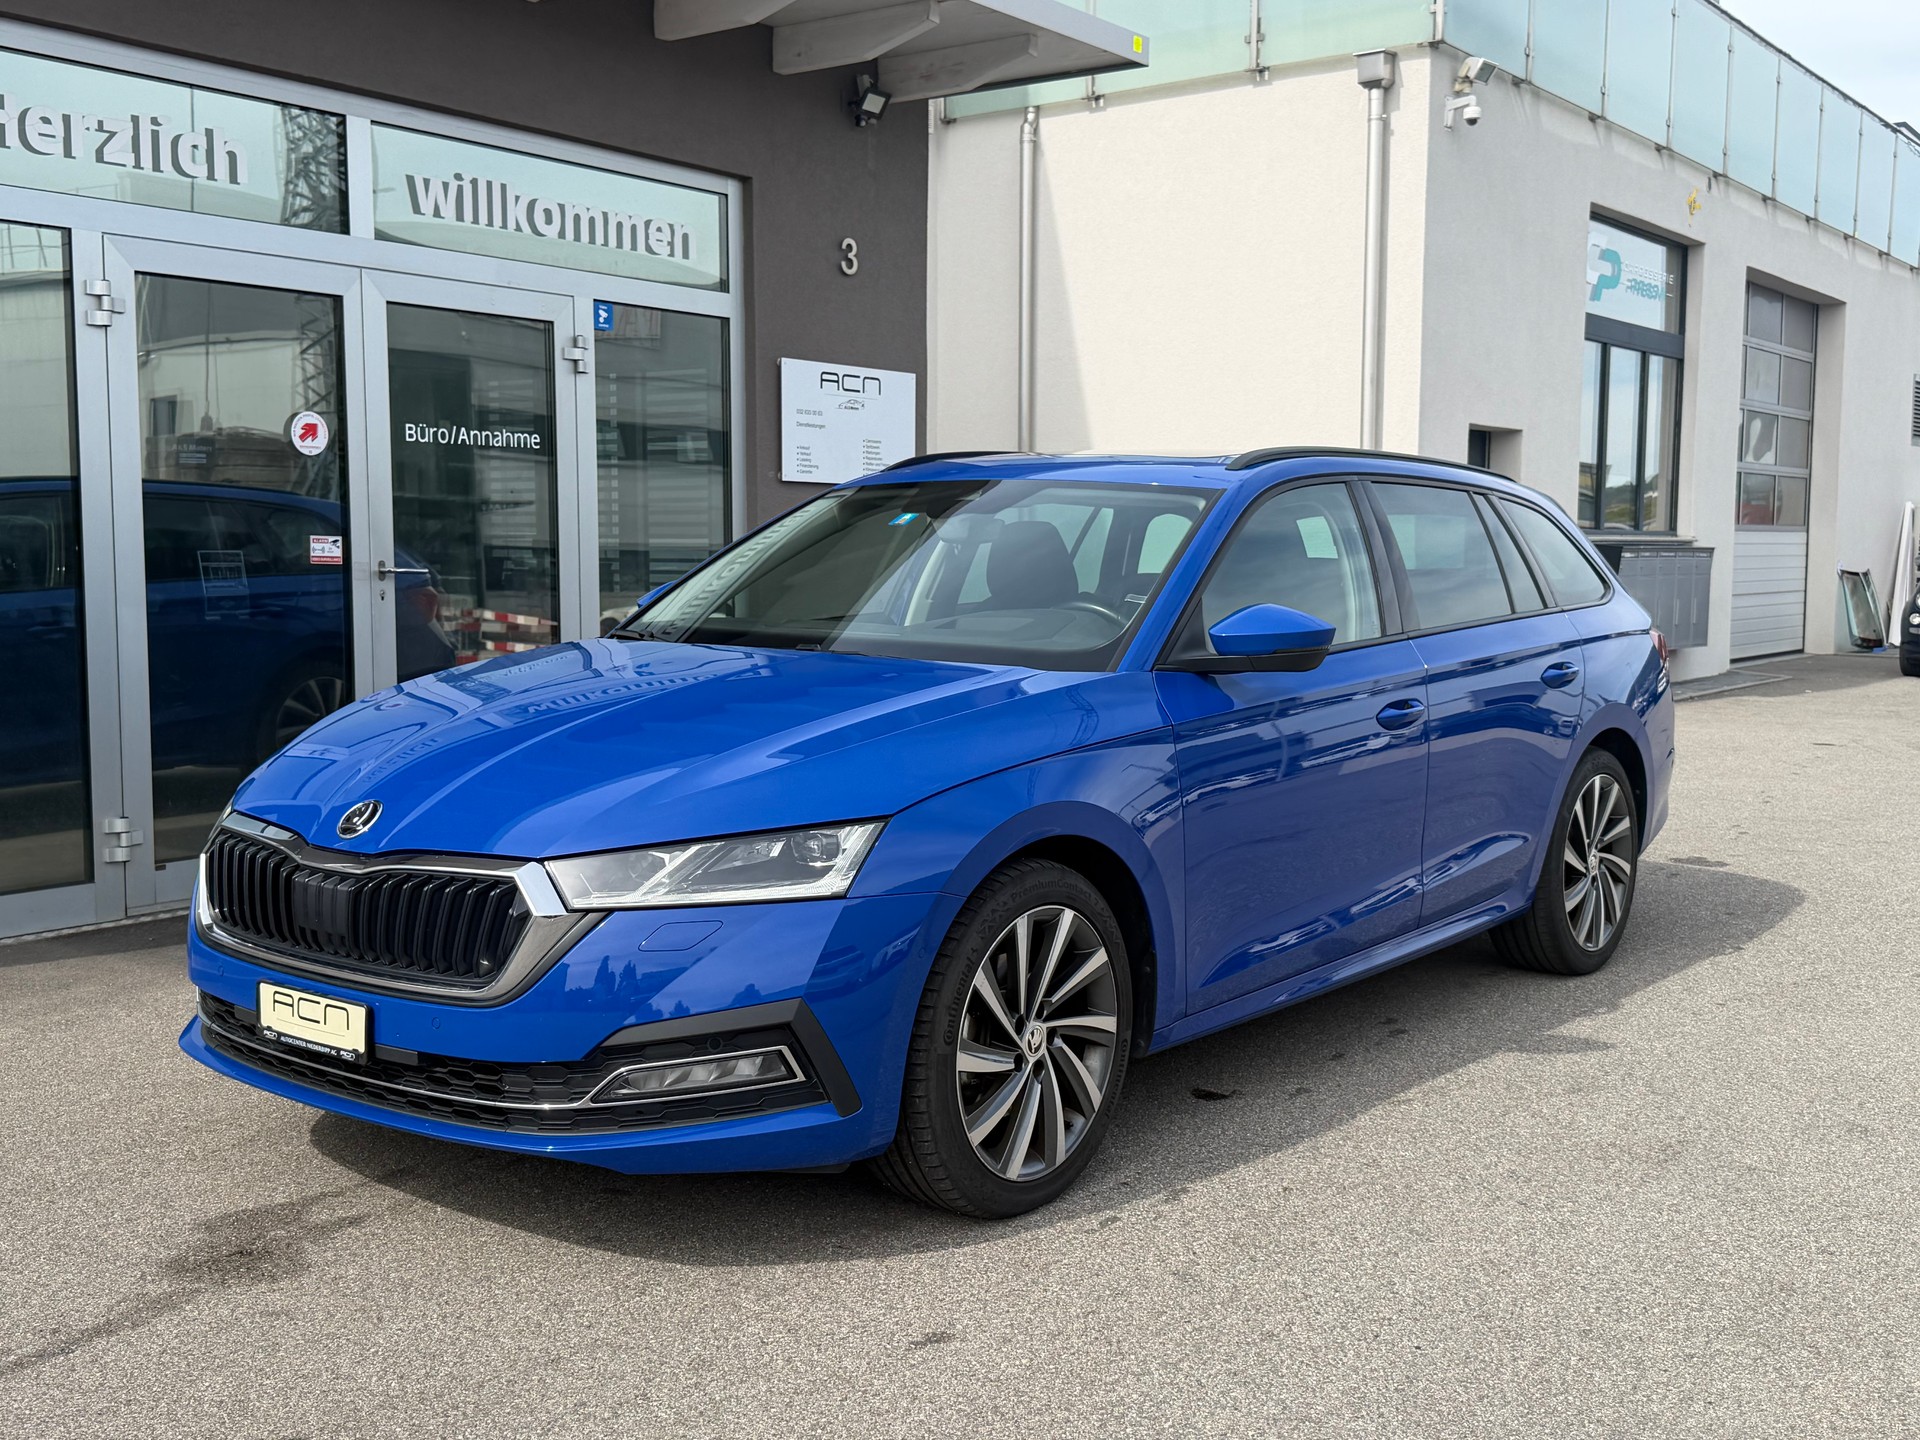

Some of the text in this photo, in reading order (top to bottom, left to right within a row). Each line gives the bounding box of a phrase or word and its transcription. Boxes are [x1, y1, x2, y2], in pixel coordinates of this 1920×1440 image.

[406, 172, 697, 260] willkommen
[841, 237, 859, 276] 3
[820, 371, 881, 395] ACN
[405, 423, 541, 449] Büro/Annahme
[273, 990, 349, 1030] ACN
